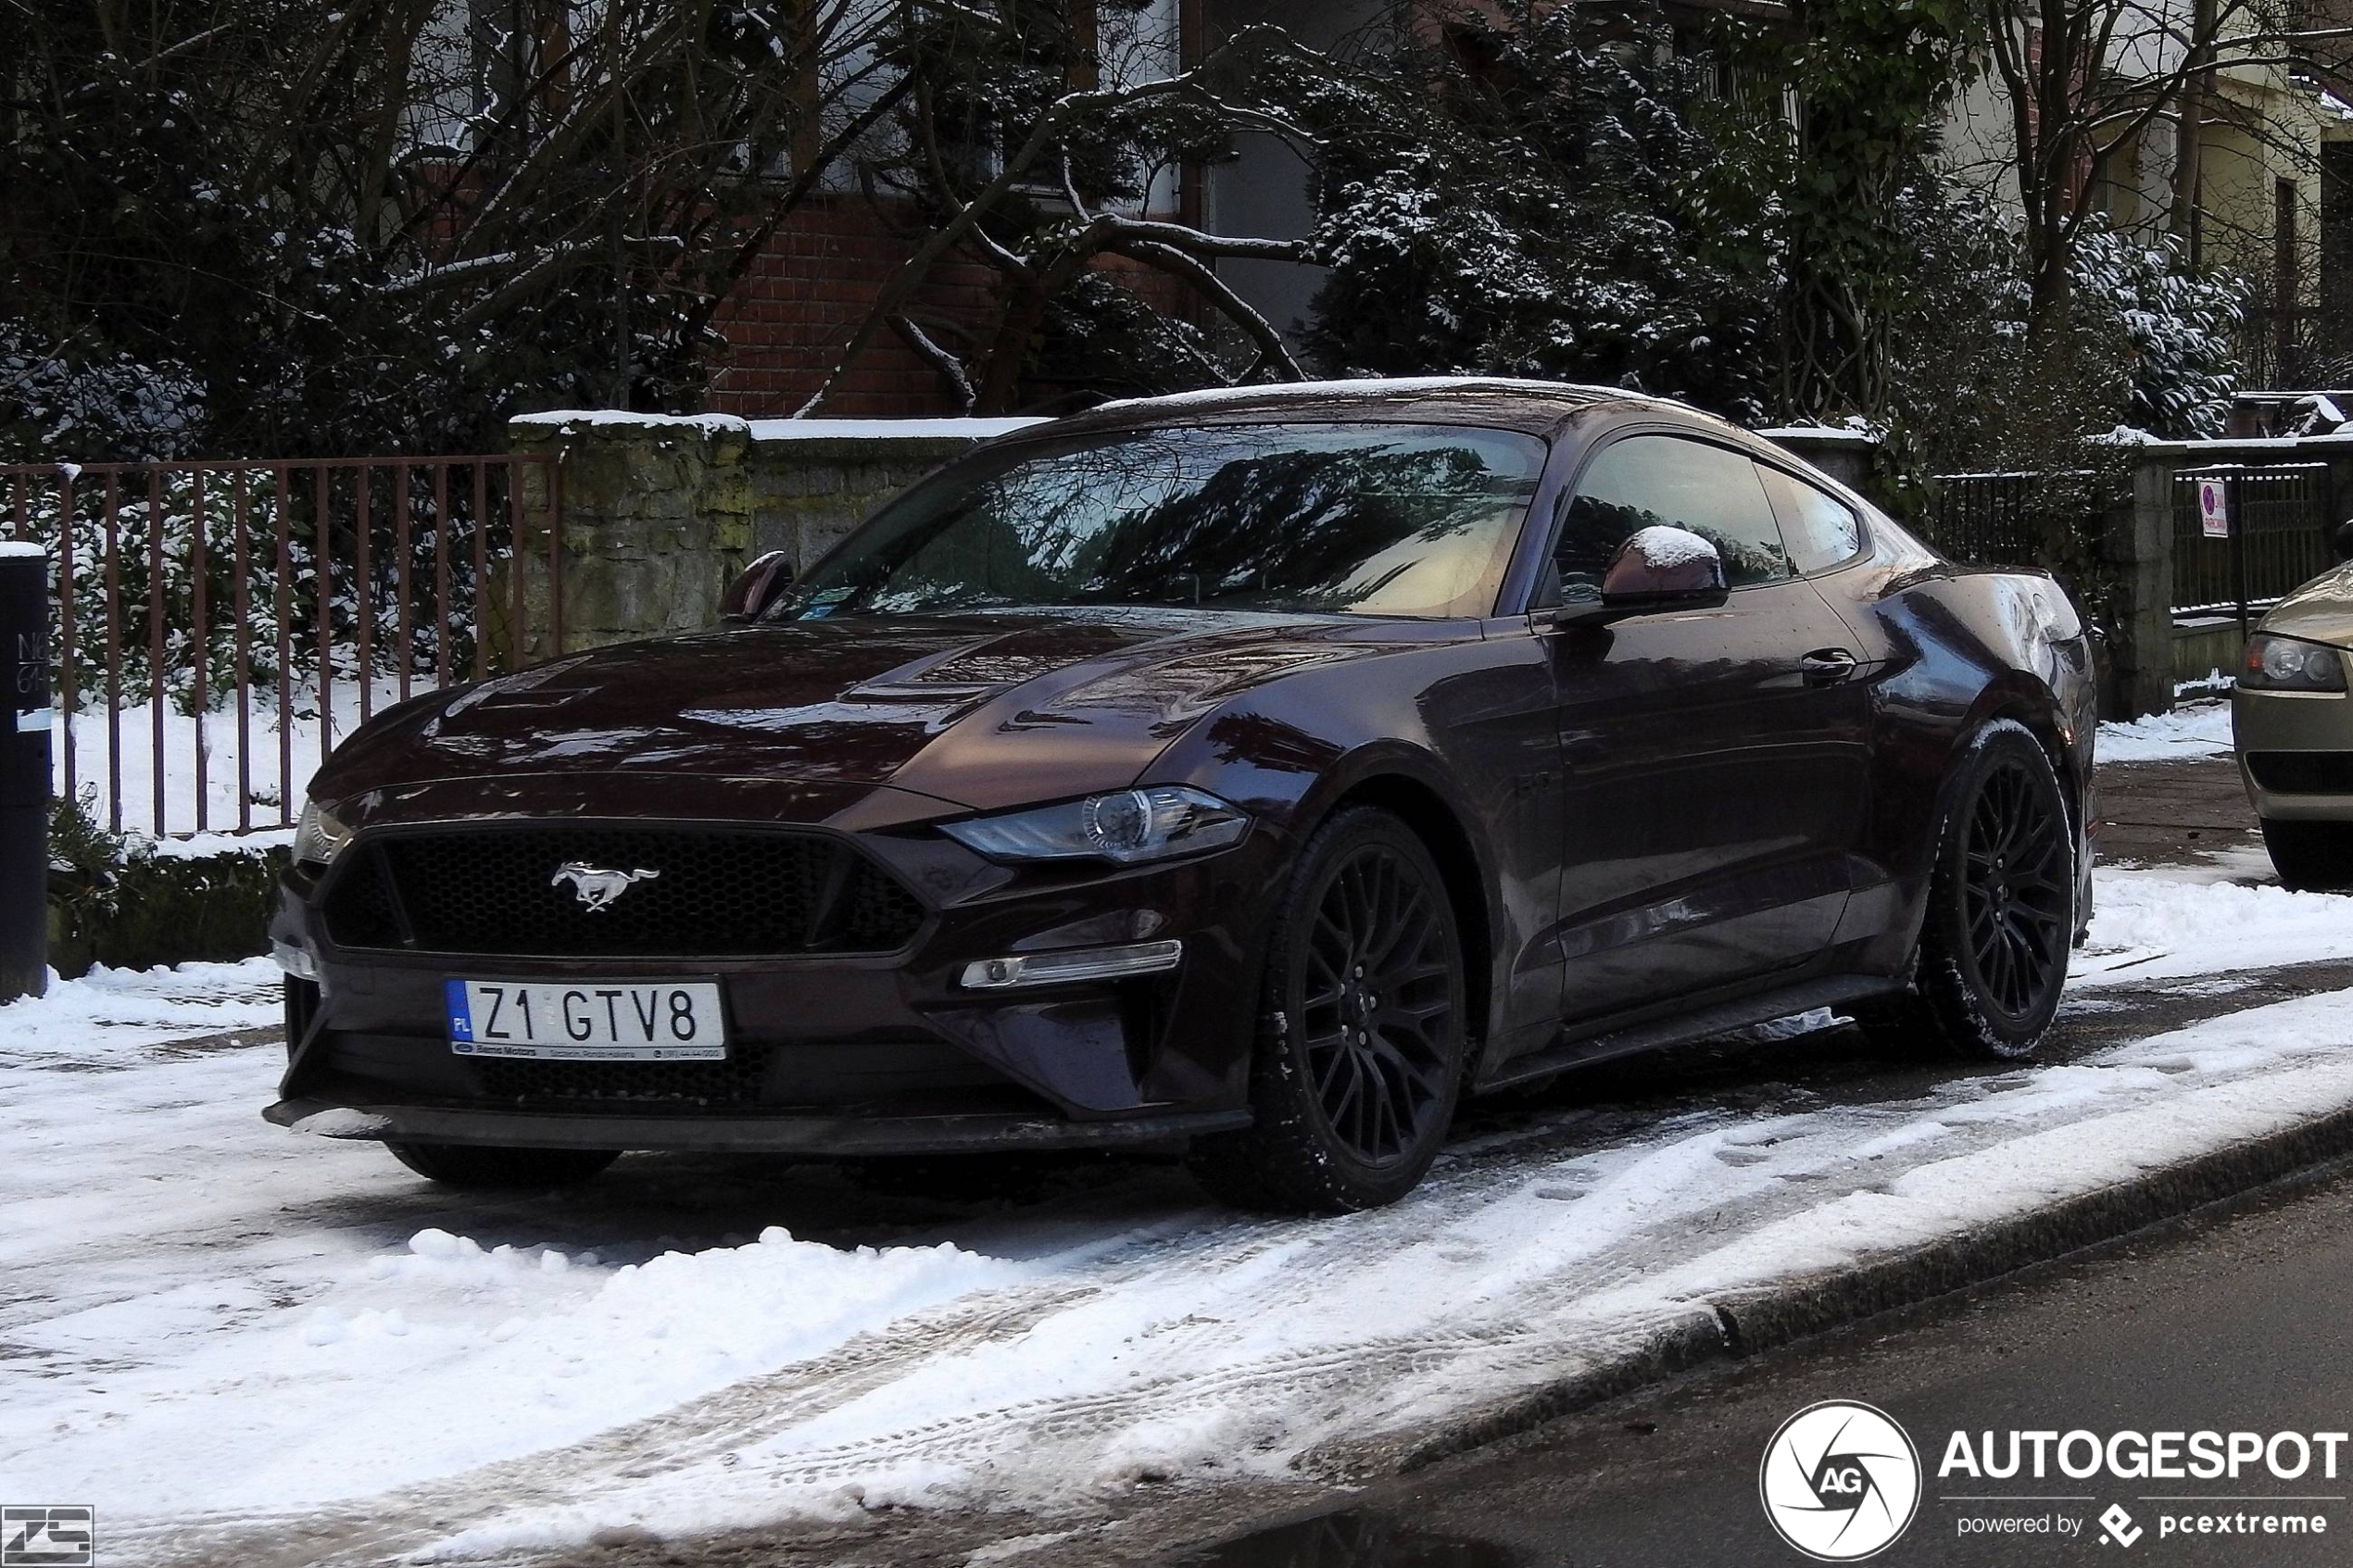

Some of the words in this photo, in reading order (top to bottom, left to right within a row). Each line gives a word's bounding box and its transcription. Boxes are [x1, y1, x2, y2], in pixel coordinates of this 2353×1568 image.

[454, 1017, 471, 1033] PL
[479, 987, 534, 1040] Z1
[563, 989, 696, 1042] GTV8
